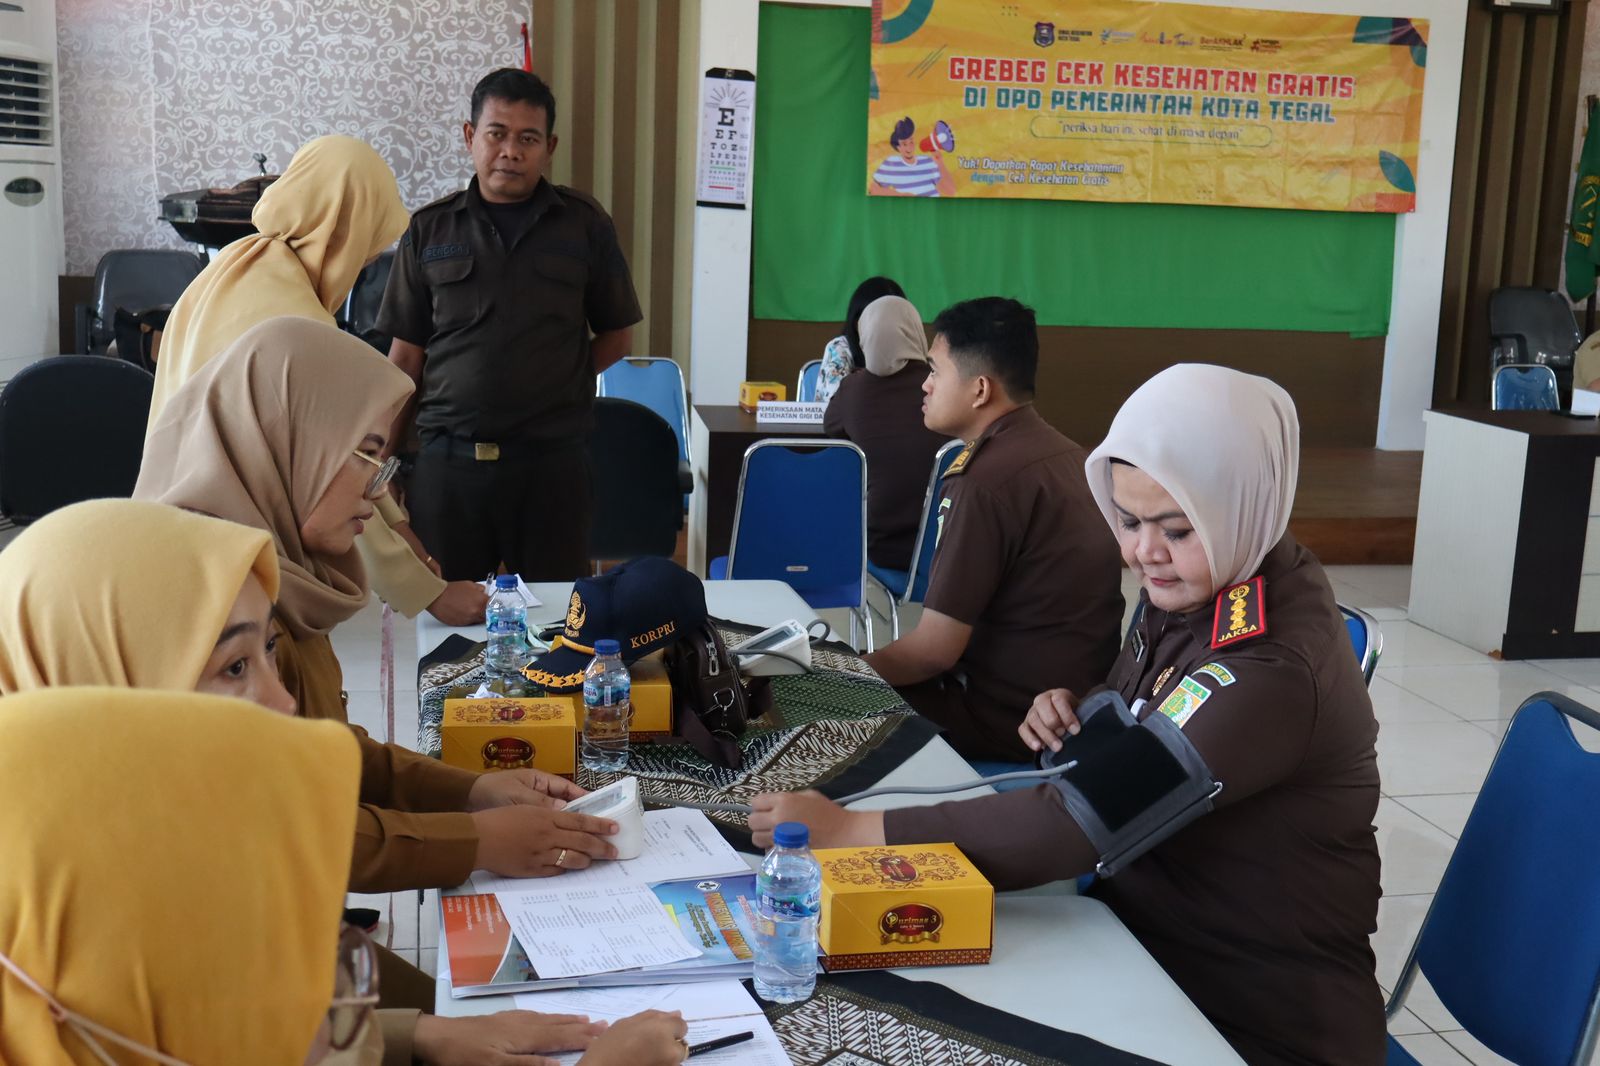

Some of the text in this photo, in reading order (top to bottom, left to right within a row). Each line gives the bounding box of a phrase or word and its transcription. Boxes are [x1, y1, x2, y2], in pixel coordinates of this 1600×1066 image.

[950, 57, 1354, 98] GREBEG CEK KESEHATAN GRATIS
[964, 87, 1336, 123] DI OPD PEMERINTAH KOTA TEGAL
[717, 107, 735, 126] E
[958, 157, 979, 169] Yuk!
[1008, 173, 1025, 183] Cek
[1029, 173, 1079, 185] Kesehatan
[1082, 174, 1110, 185] Gratis
[630, 620, 676, 649] KORPRI
[1218, 625, 1258, 643] JAKSA
[930, 914, 937, 924] 3
